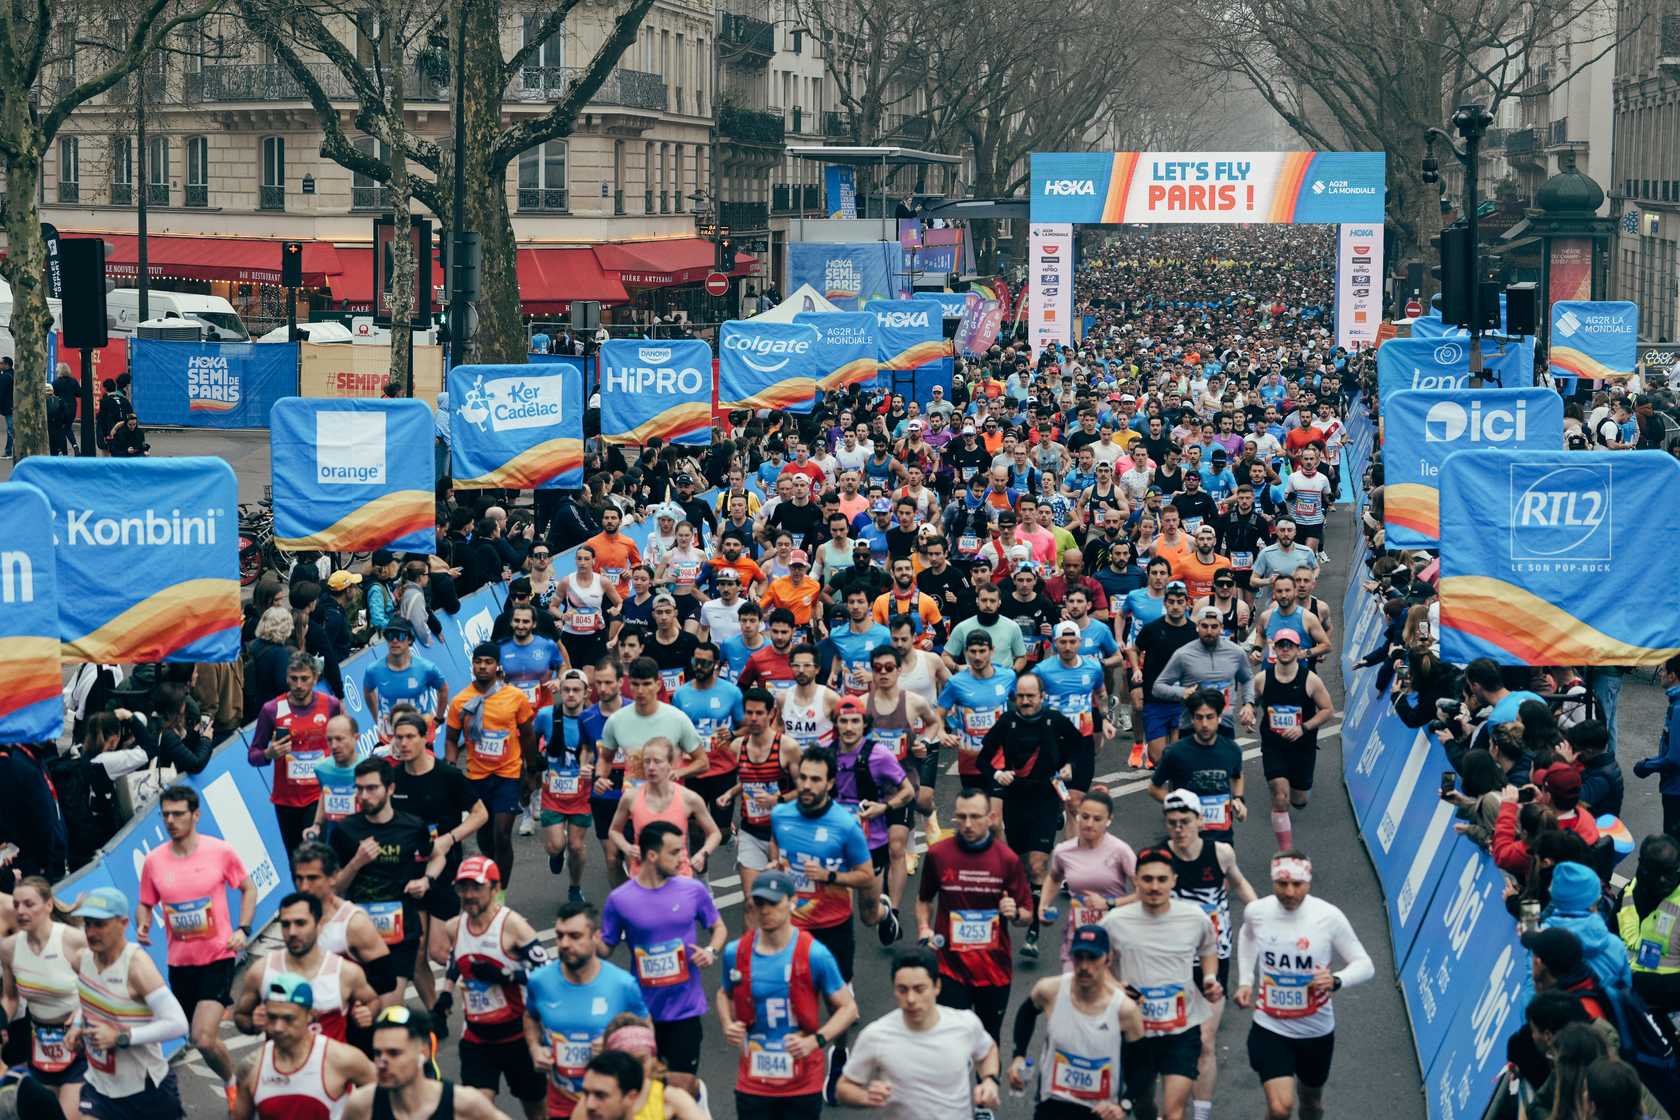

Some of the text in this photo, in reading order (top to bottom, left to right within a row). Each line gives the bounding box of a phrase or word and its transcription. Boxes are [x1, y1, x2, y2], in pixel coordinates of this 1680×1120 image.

[1153, 161, 1251, 181] LET'S FLY
[1044, 179, 1096, 196] HOKA
[1148, 184, 1255, 211] PARIS !
[825, 259, 853, 268] HOKA
[252, 271, 281, 281] RESTAURANT
[825, 268, 853, 280] SEMI
[825, 279, 861, 291] PARIS
[351, 304, 370, 313] CAFÉ
[876, 311, 929, 328] HOKA
[1585, 316, 1624, 325] AG2R LA
[827, 327, 865, 336] AG2R LA
[1585, 325, 1632, 333] MONDIALE
[723, 333, 810, 356] Colgate
[826, 335, 873, 345] MONDIALE
[188, 356, 229, 369] HOKA
[640, 349, 671, 360] DANONE
[187, 368, 240, 385] SEMI DE
[607, 366, 703, 394] HiPRO
[188, 384, 240, 401] PARIS
[508, 381, 541, 404] Ker
[494, 400, 559, 421] Cadélac
[1470, 400, 1526, 442] ici
[321, 463, 379, 481] orange
[1520, 490, 1602, 527] RTL2
[66, 508, 217, 546] Konbini
[1511, 563, 1611, 572] LE SON POP-ROCK
[785, 720, 816, 732] SAM
[327, 795, 351, 811] 4345
[958, 924, 986, 939] 4253
[643, 957, 675, 974] 10523
[1264, 951, 1313, 970] SAM
[1270, 989, 1303, 1006] 5058
[1064, 1068, 1093, 1088] 2916
